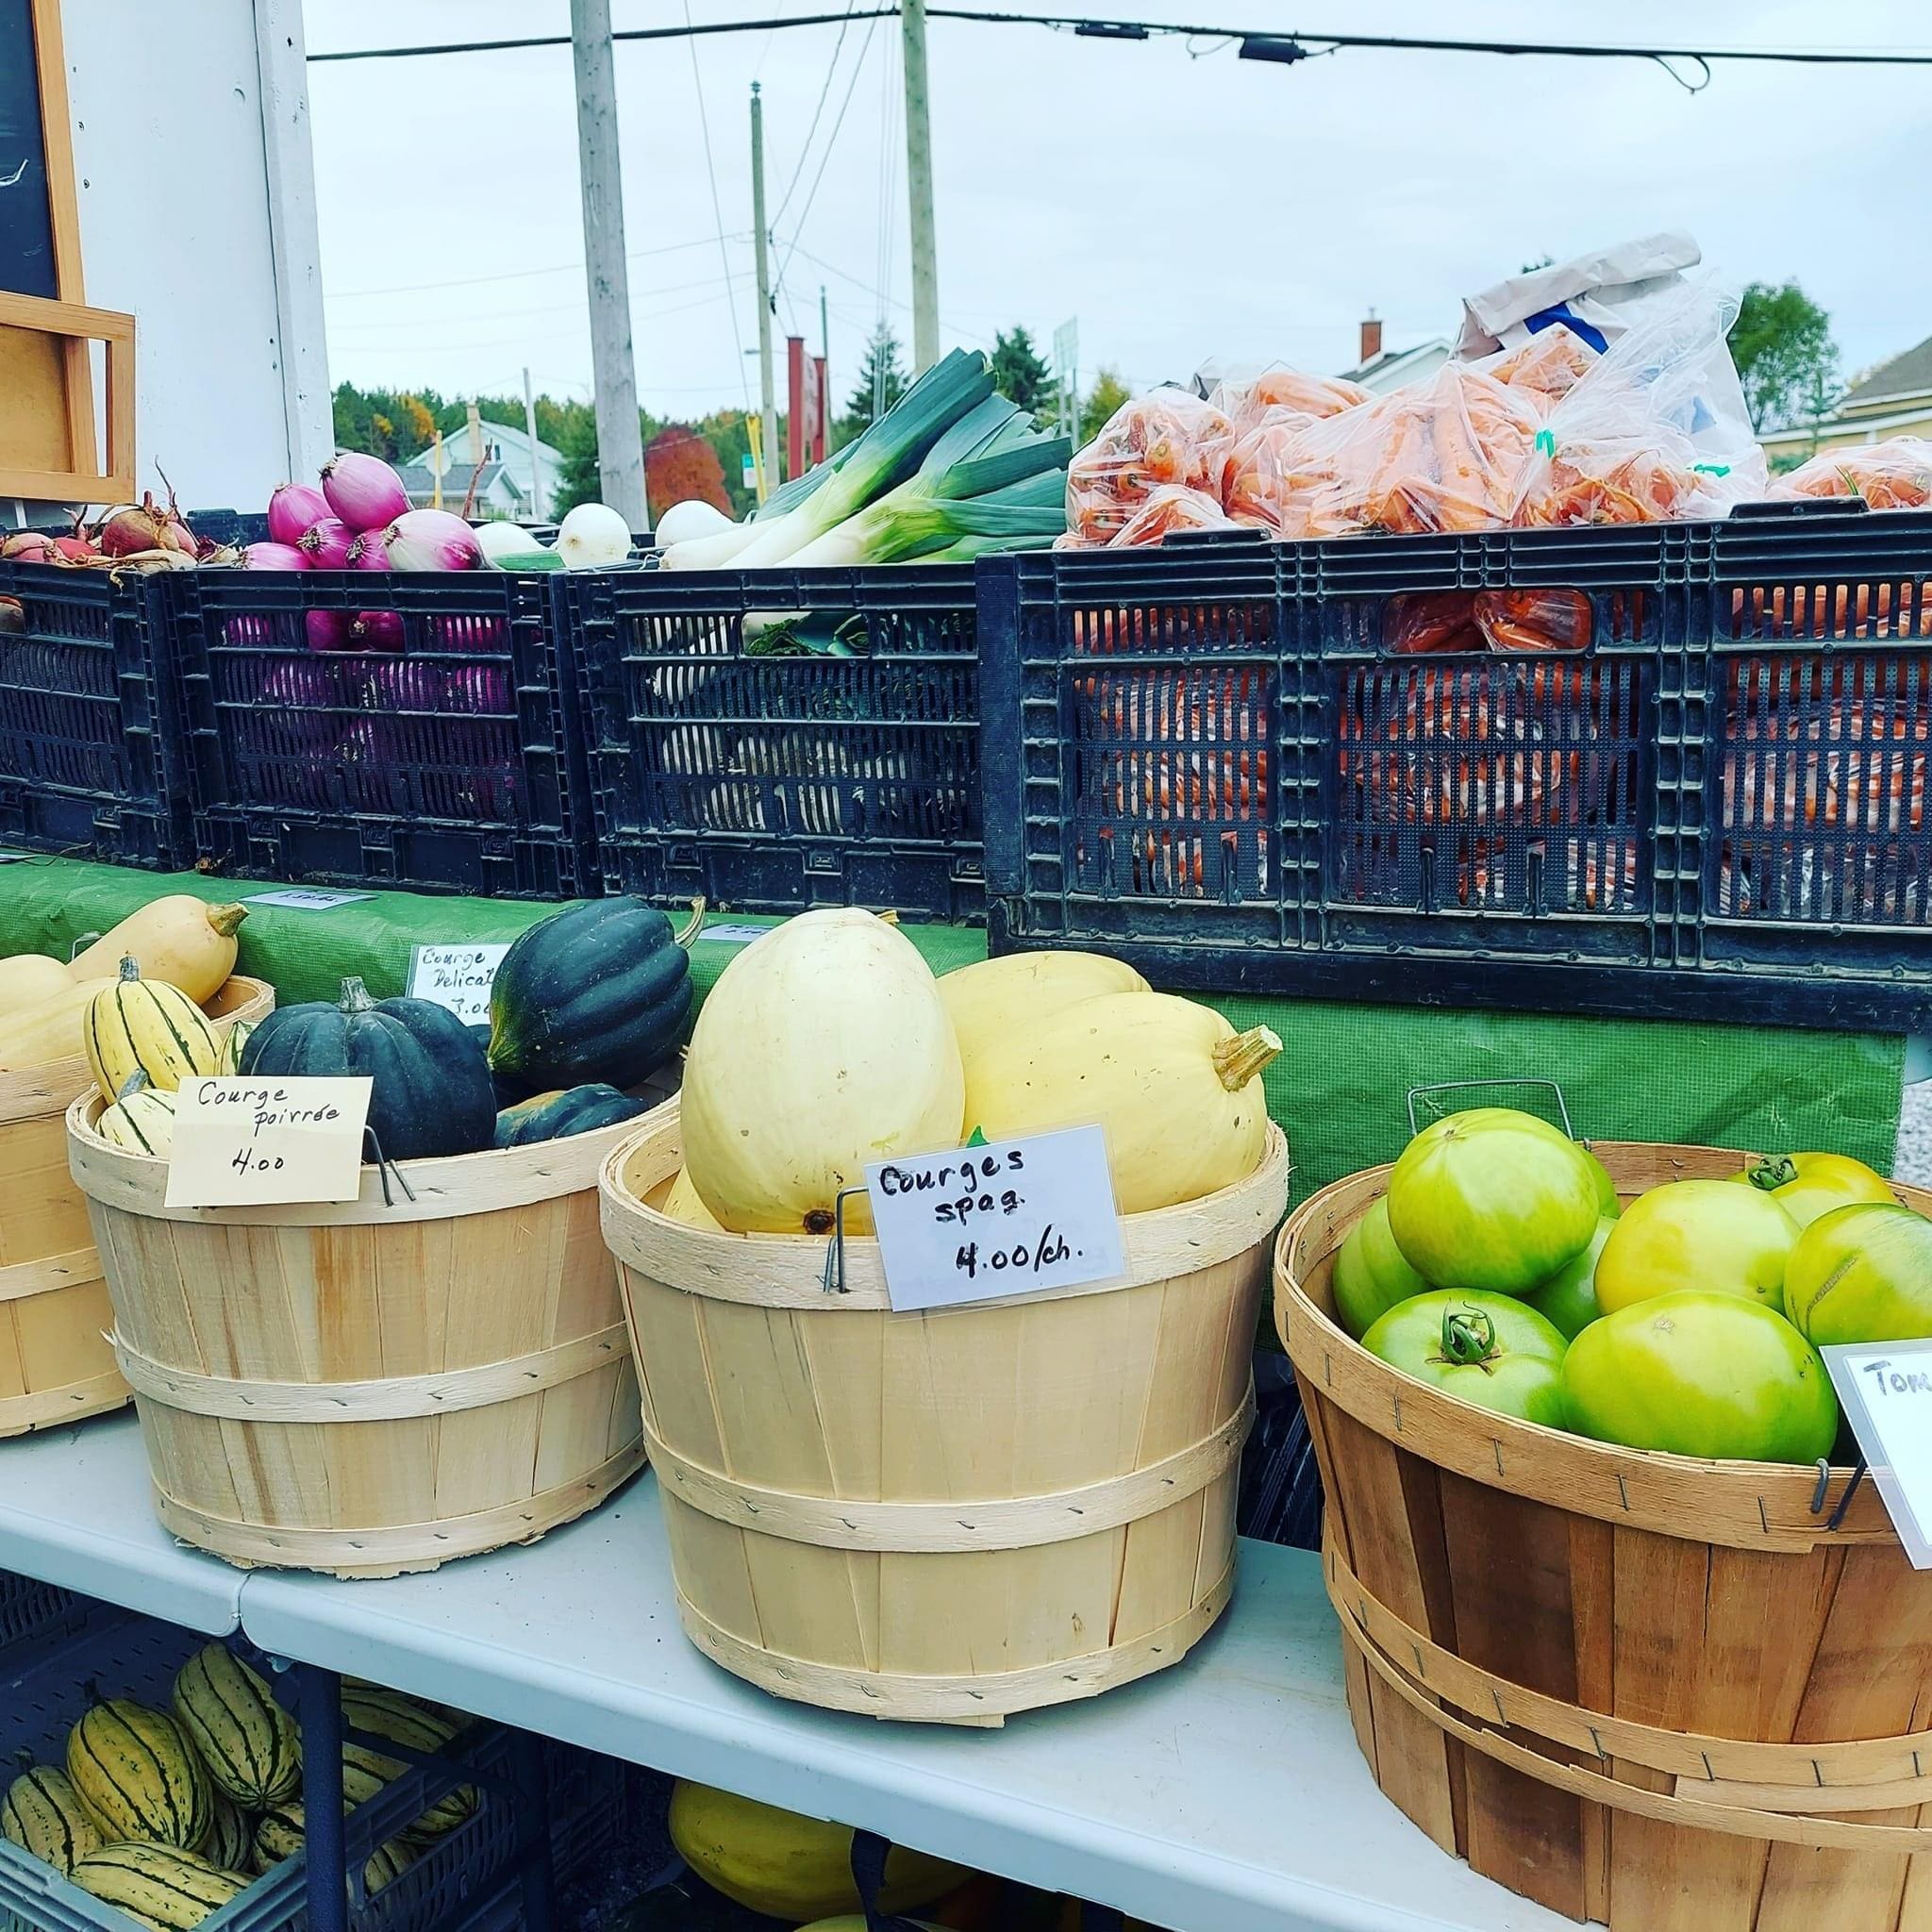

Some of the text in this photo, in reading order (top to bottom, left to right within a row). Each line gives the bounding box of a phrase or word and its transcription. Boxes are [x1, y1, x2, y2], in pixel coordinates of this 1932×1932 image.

[423, 947, 485, 971] Courge
[198, 1081, 288, 1109] Courge
[254, 1104, 340, 1137] poivrée
[232, 1147, 284, 1175] 4.00
[879, 1150, 1024, 1195] Courges
[956, 1224, 1083, 1278] 4.00/ch.
